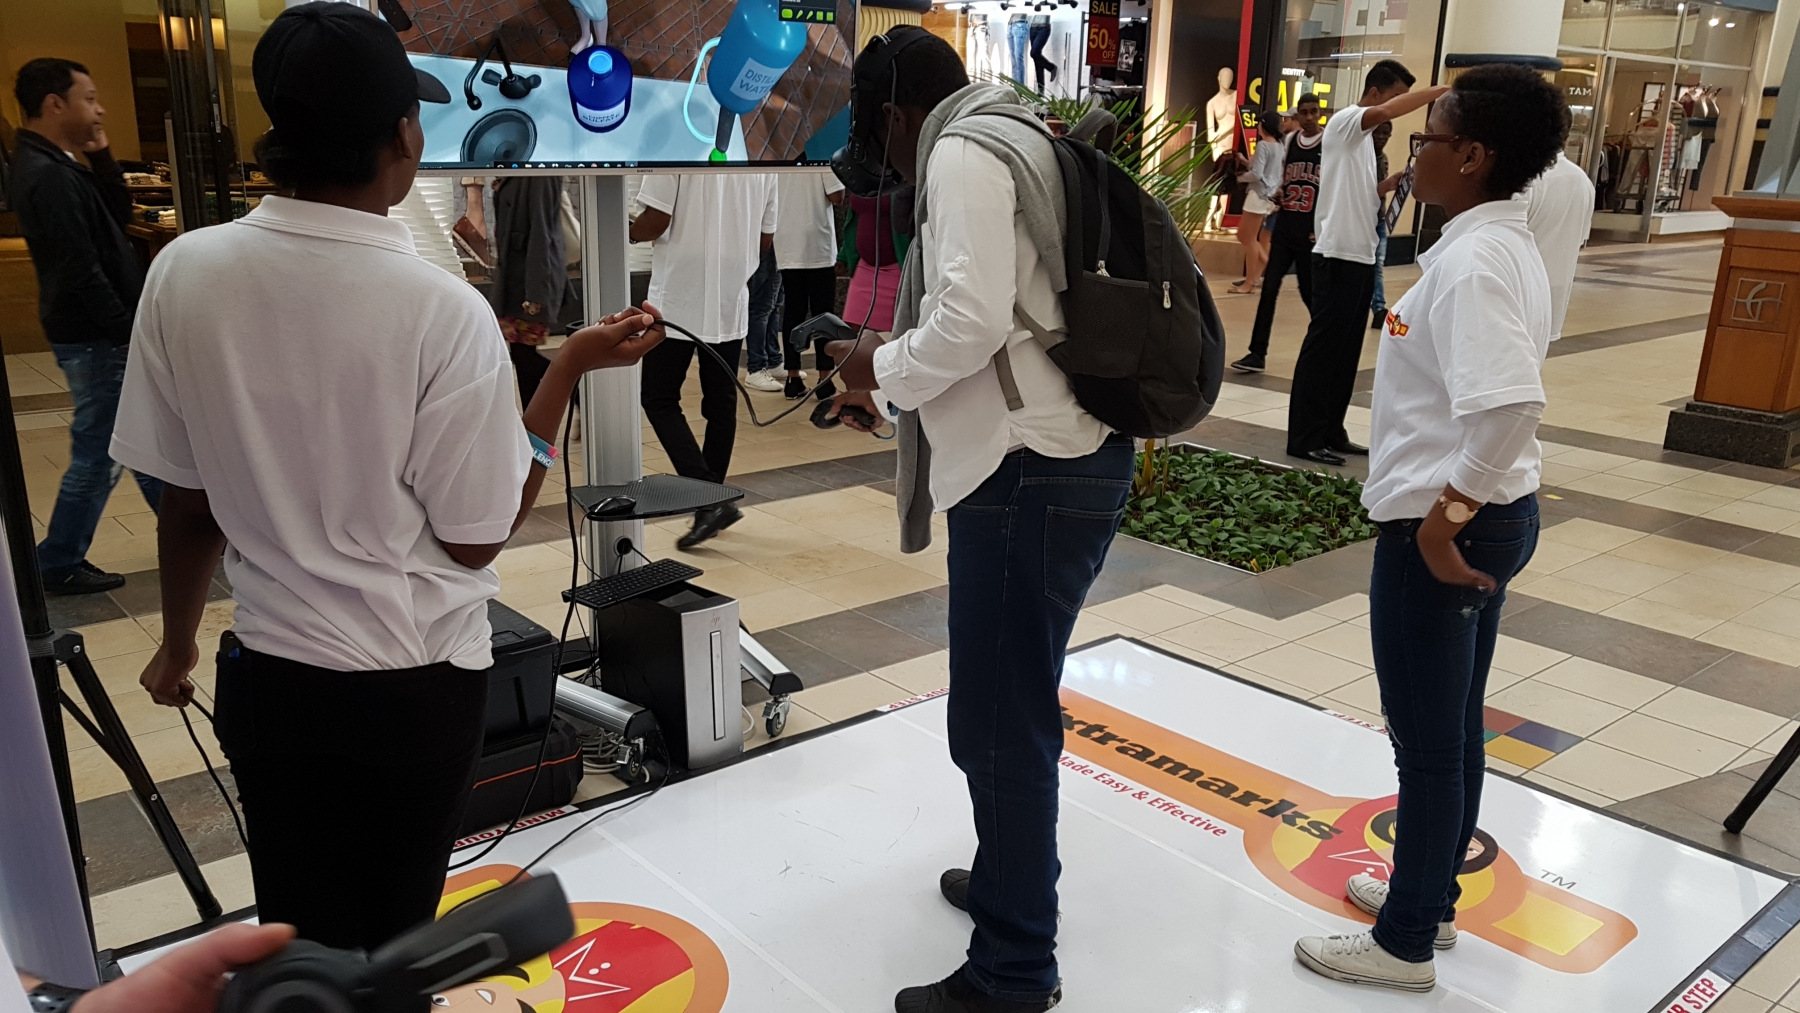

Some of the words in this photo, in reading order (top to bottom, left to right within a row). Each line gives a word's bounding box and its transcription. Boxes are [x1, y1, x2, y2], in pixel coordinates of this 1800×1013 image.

[1091, 1, 1118, 15] SALE
[1102, 51, 1115, 59] OFF
[1282, 185, 1315, 212] 23
[1061, 706, 1343, 840] xtramarks
[1093, 772, 1133, 793] Easy
[1132, 791, 1149, 801] &
[1147, 797, 1227, 837] Effective
[515, 809, 566, 829] MIND
[1541, 869, 1576, 889] TM
[1682, 978, 1718, 1009] STEP
